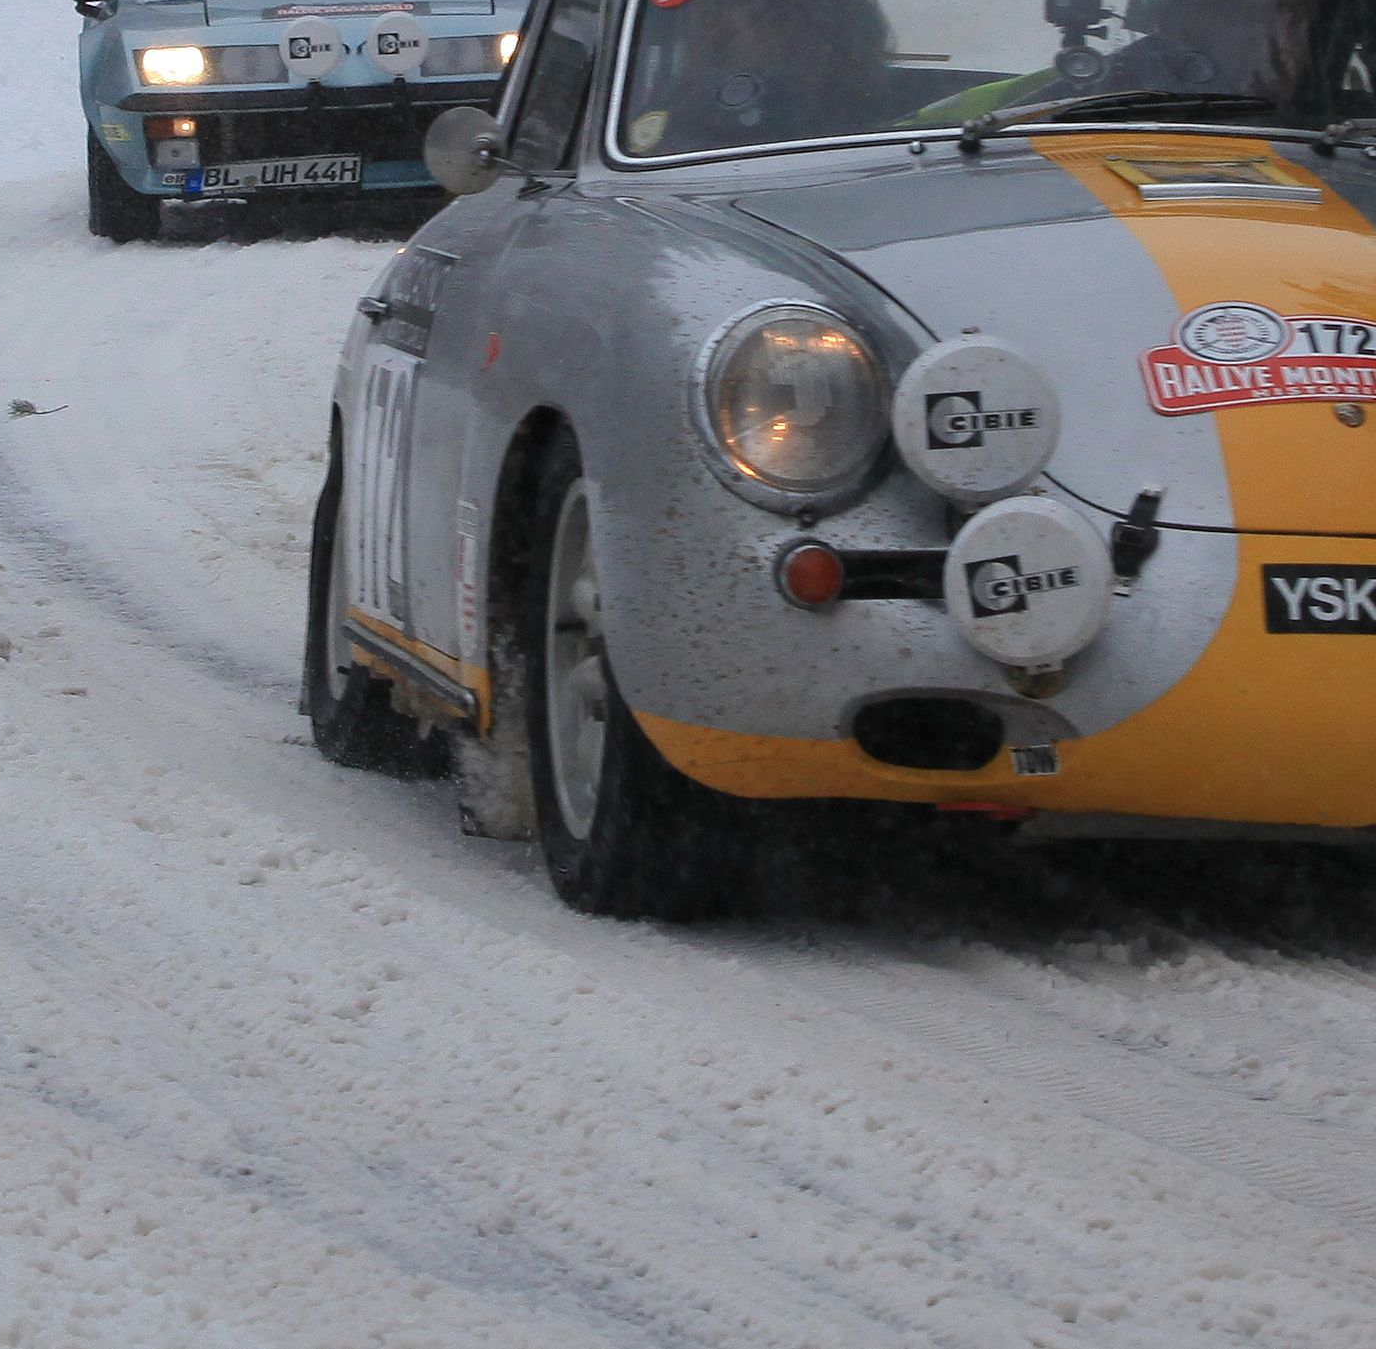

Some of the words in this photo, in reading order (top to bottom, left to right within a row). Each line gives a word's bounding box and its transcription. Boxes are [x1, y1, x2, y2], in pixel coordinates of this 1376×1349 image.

[203, 167, 240, 188] BL
[261, 163, 298, 185] UH
[302, 159, 358, 182] 44H
[1153, 361, 1274, 399] RALLYE
[949, 410, 1036, 432] CIBIE
[991, 567, 1078, 597] CIBIE
